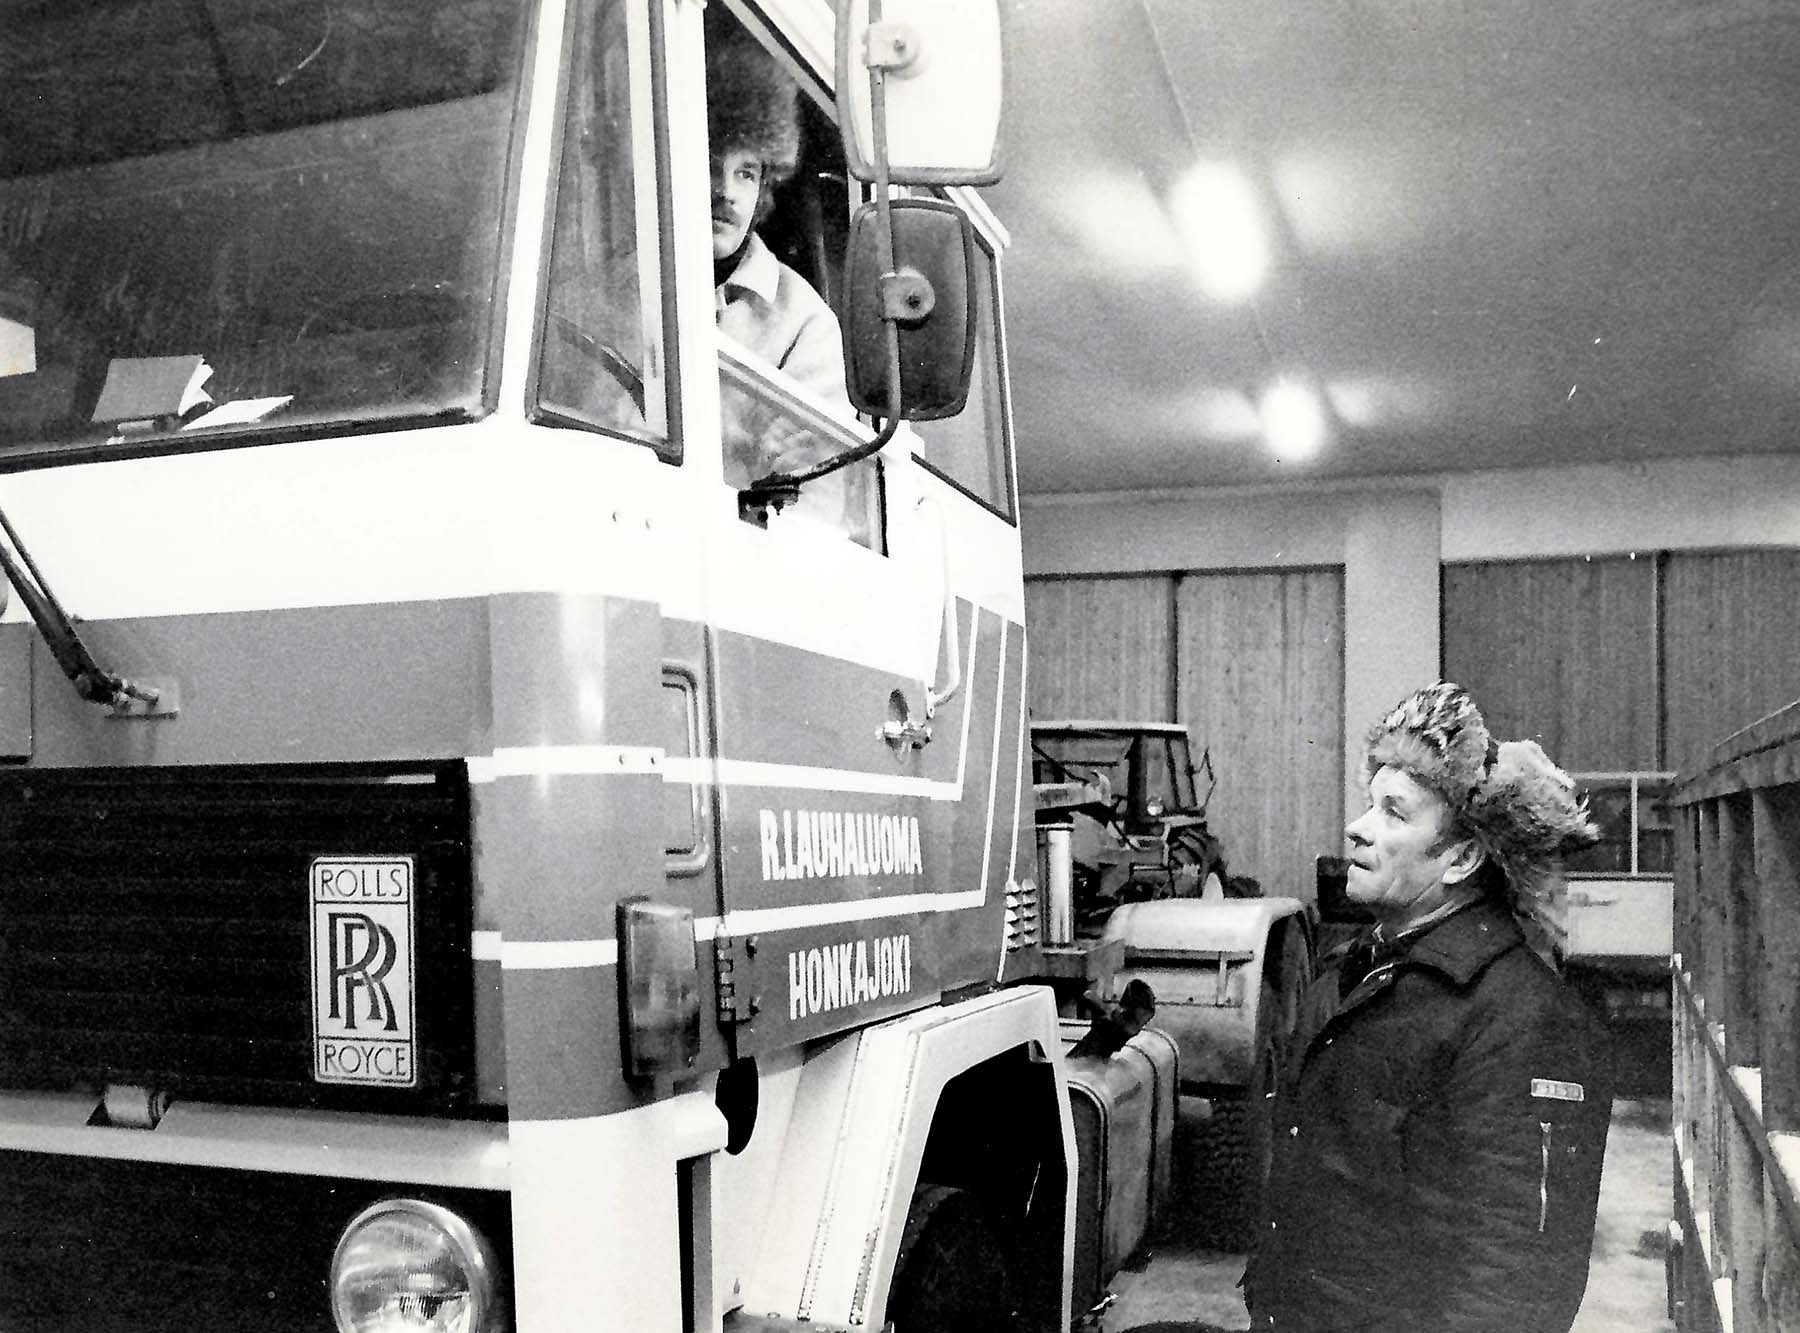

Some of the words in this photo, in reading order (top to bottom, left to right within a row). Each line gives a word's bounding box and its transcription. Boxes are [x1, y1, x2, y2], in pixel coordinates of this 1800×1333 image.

[321, 869, 402, 897] ROLLS
[328, 912, 398, 1031] RR
[789, 935, 911, 1020] HONKAJOKI
[324, 1045, 406, 1076] ROYCE
